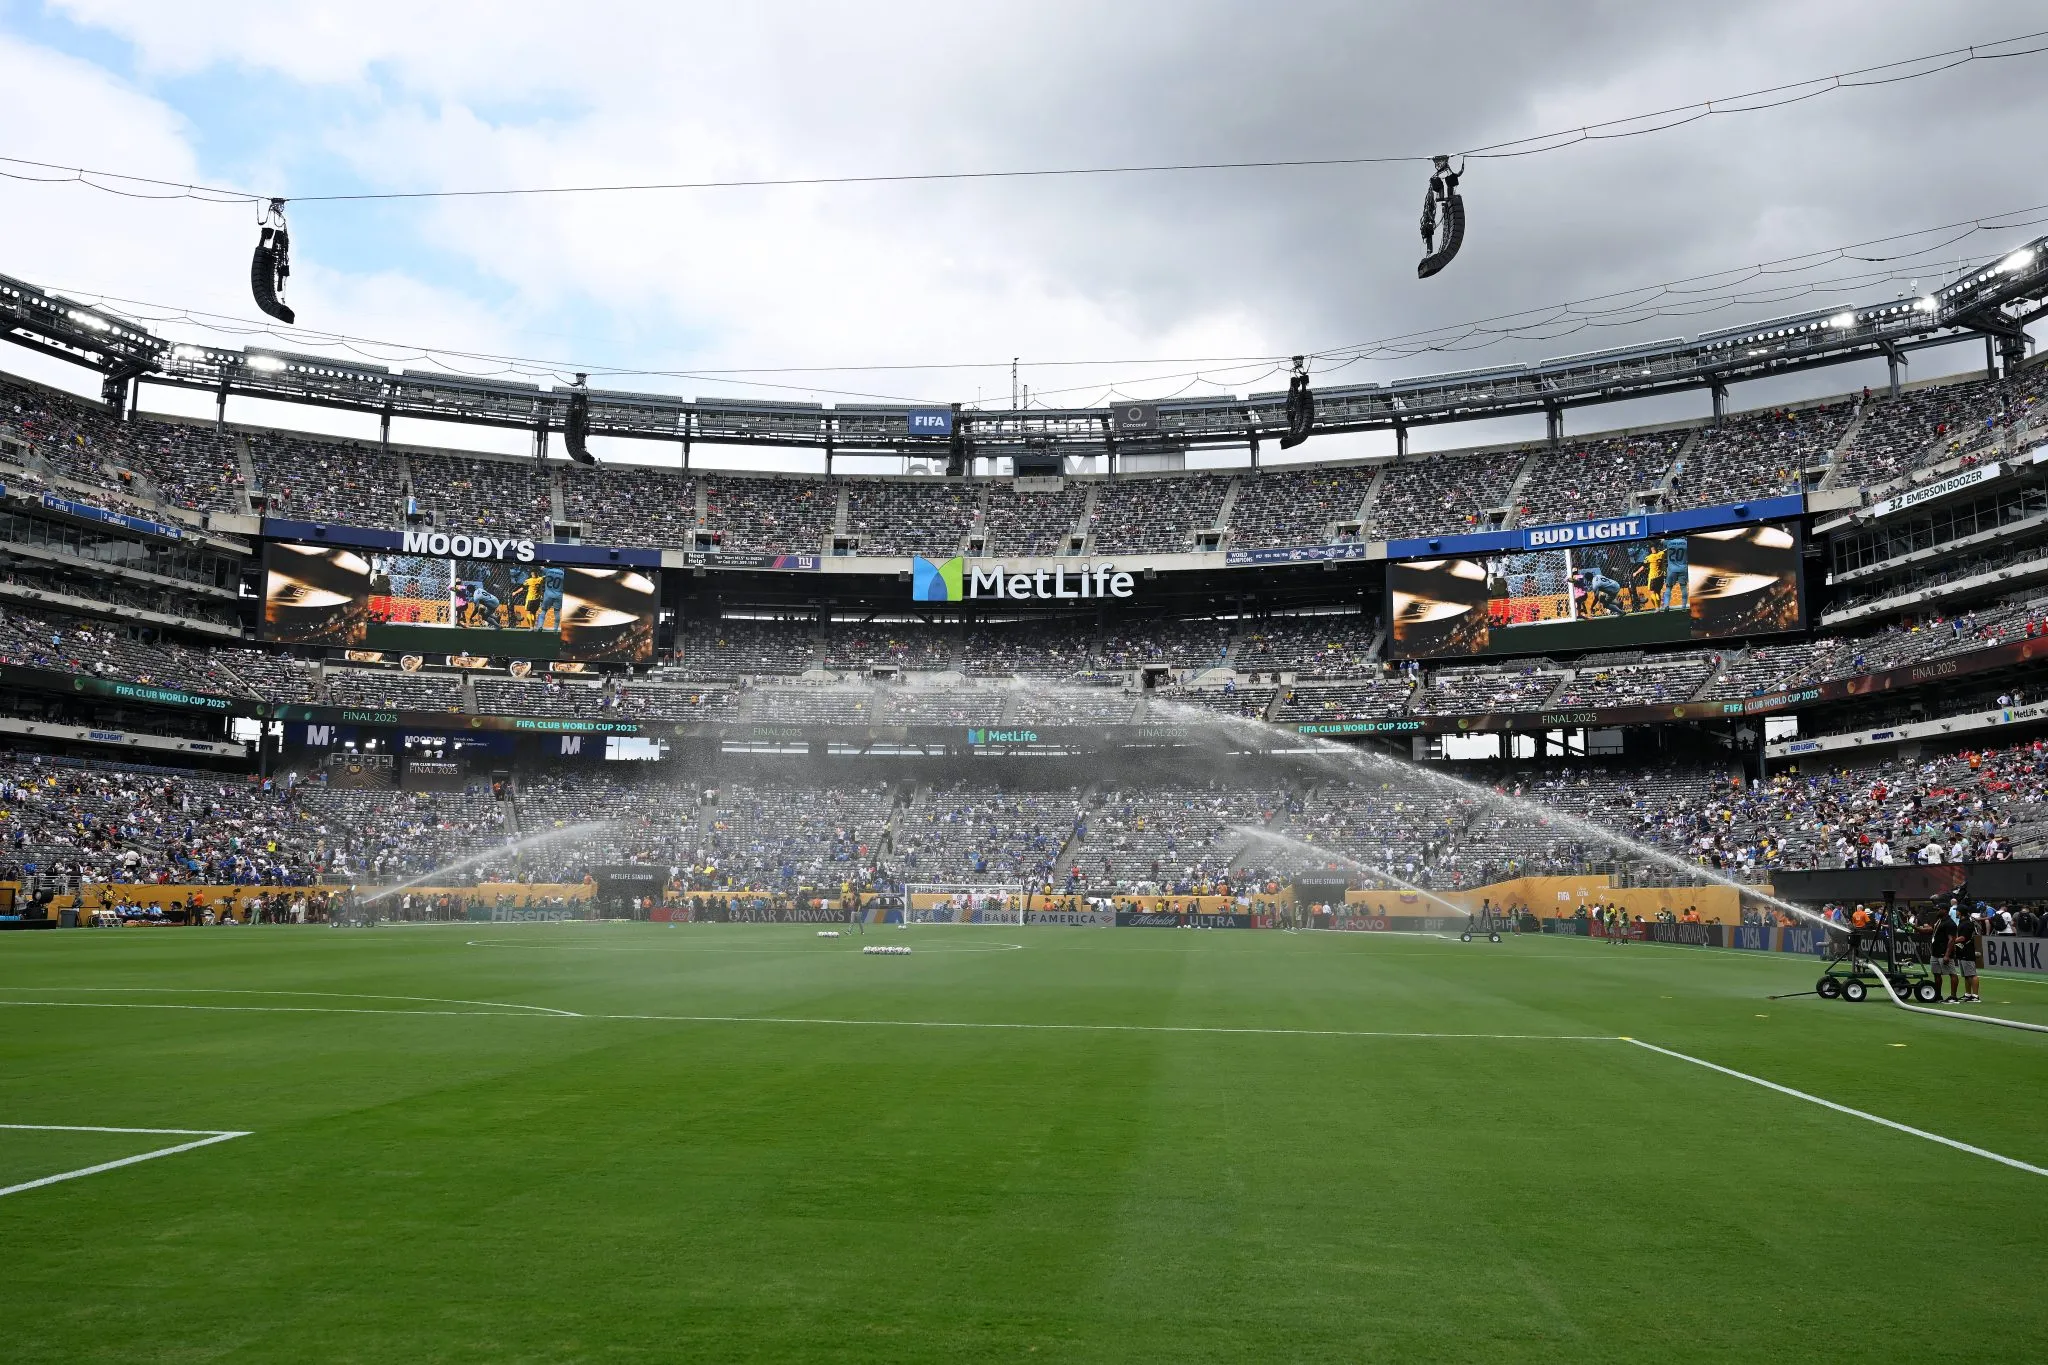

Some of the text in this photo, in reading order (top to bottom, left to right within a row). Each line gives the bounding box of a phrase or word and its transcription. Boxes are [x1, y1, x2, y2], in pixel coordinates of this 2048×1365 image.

[915, 416, 945, 427] FIFA
[1906, 482, 1946, 504] EMERSON
[1947, 470, 1982, 491] BOOZER
[1530, 528, 1574, 546] BUD
[402, 531, 535, 562] MOODY'S
[1668, 547, 1685, 562] 20
[546, 575, 561, 590] 20
[970, 562, 1135, 600] MetLife
[1912, 660, 1957, 680] FINAL 2025
[116, 685, 134, 696] FIFA
[136, 688, 158, 699] CLUB
[159, 691, 188, 703] WORLD
[189, 696, 205, 706] CUP
[1747, 701, 1764, 711] CLUB
[1764, 696, 1787, 708] WORLD
[1787, 693, 1801, 703] CUP
[343, 711, 398, 723] FINAL 2025
[1542, 713, 1597, 724] FINAL 2025
[2013, 707, 2038, 719] MetLife
[516, 720, 535, 728] FIFA
[537, 721, 560, 729] CLUB
[562, 722, 594, 731] WORLD
[596, 723, 613, 731] CUP
[753, 727, 803, 737] FINAL 2025
[1298, 725, 1317, 733] FIFA
[1318, 724, 1342, 733] CLUB
[1343, 723, 1375, 732] WORLD
[1376, 723, 1394, 731] CUP
[90, 731, 123, 742] BUD LIGHT
[988, 730, 1038, 742] MetLife
[1138, 728, 1189, 737] FINAL 2025
[1790, 742, 1816, 751] BUD LIGHT
[409, 766, 458, 775] FINAL 2025
[1557, 891, 1570, 901] FIFA
[491, 906, 573, 921] Hisense
[728, 909, 845, 922] QATAR AIRWAYS
[984, 913, 1018, 923] BANK
[1039, 914, 1097, 924] AMERICA
[1129, 914, 1236, 927] Michelob ULTRA
[1424, 919, 1444, 929] PIF
[1653, 923, 1676, 943] QATAR
[1678, 924, 1711, 944] AIRWAYS
[1740, 927, 1761, 949] VISA
[1789, 930, 1814, 953] VISA
[1987, 940, 2042, 970] BANK
